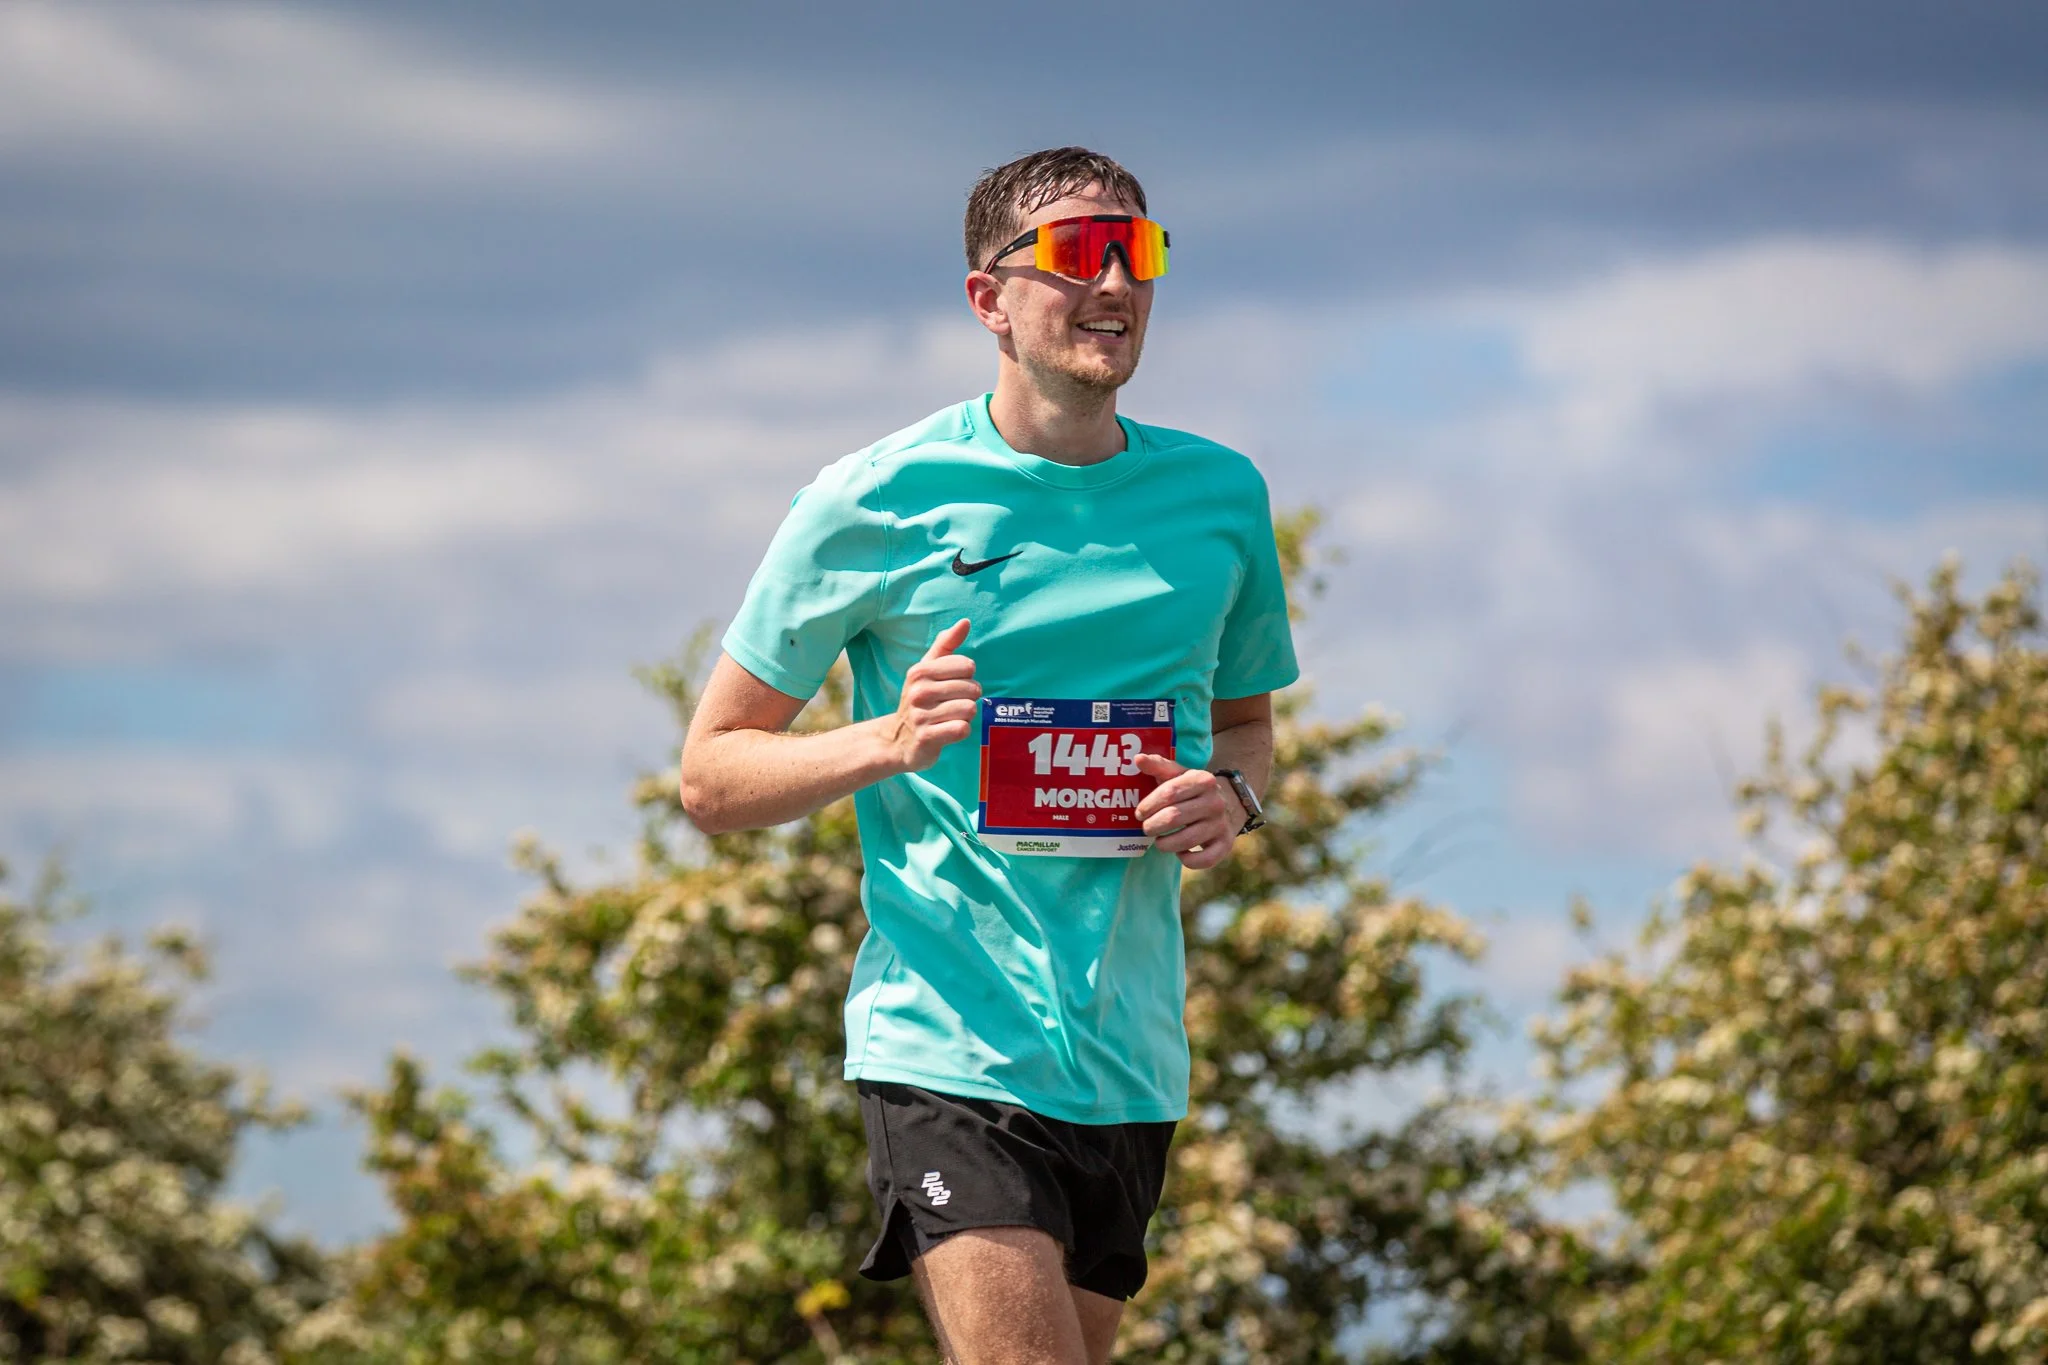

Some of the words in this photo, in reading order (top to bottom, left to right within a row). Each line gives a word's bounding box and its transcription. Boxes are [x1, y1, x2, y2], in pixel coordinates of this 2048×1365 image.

[996, 702, 1032, 716] emf
[1028, 733, 1142, 776] 1443
[1034, 788, 1139, 809] MORGAN
